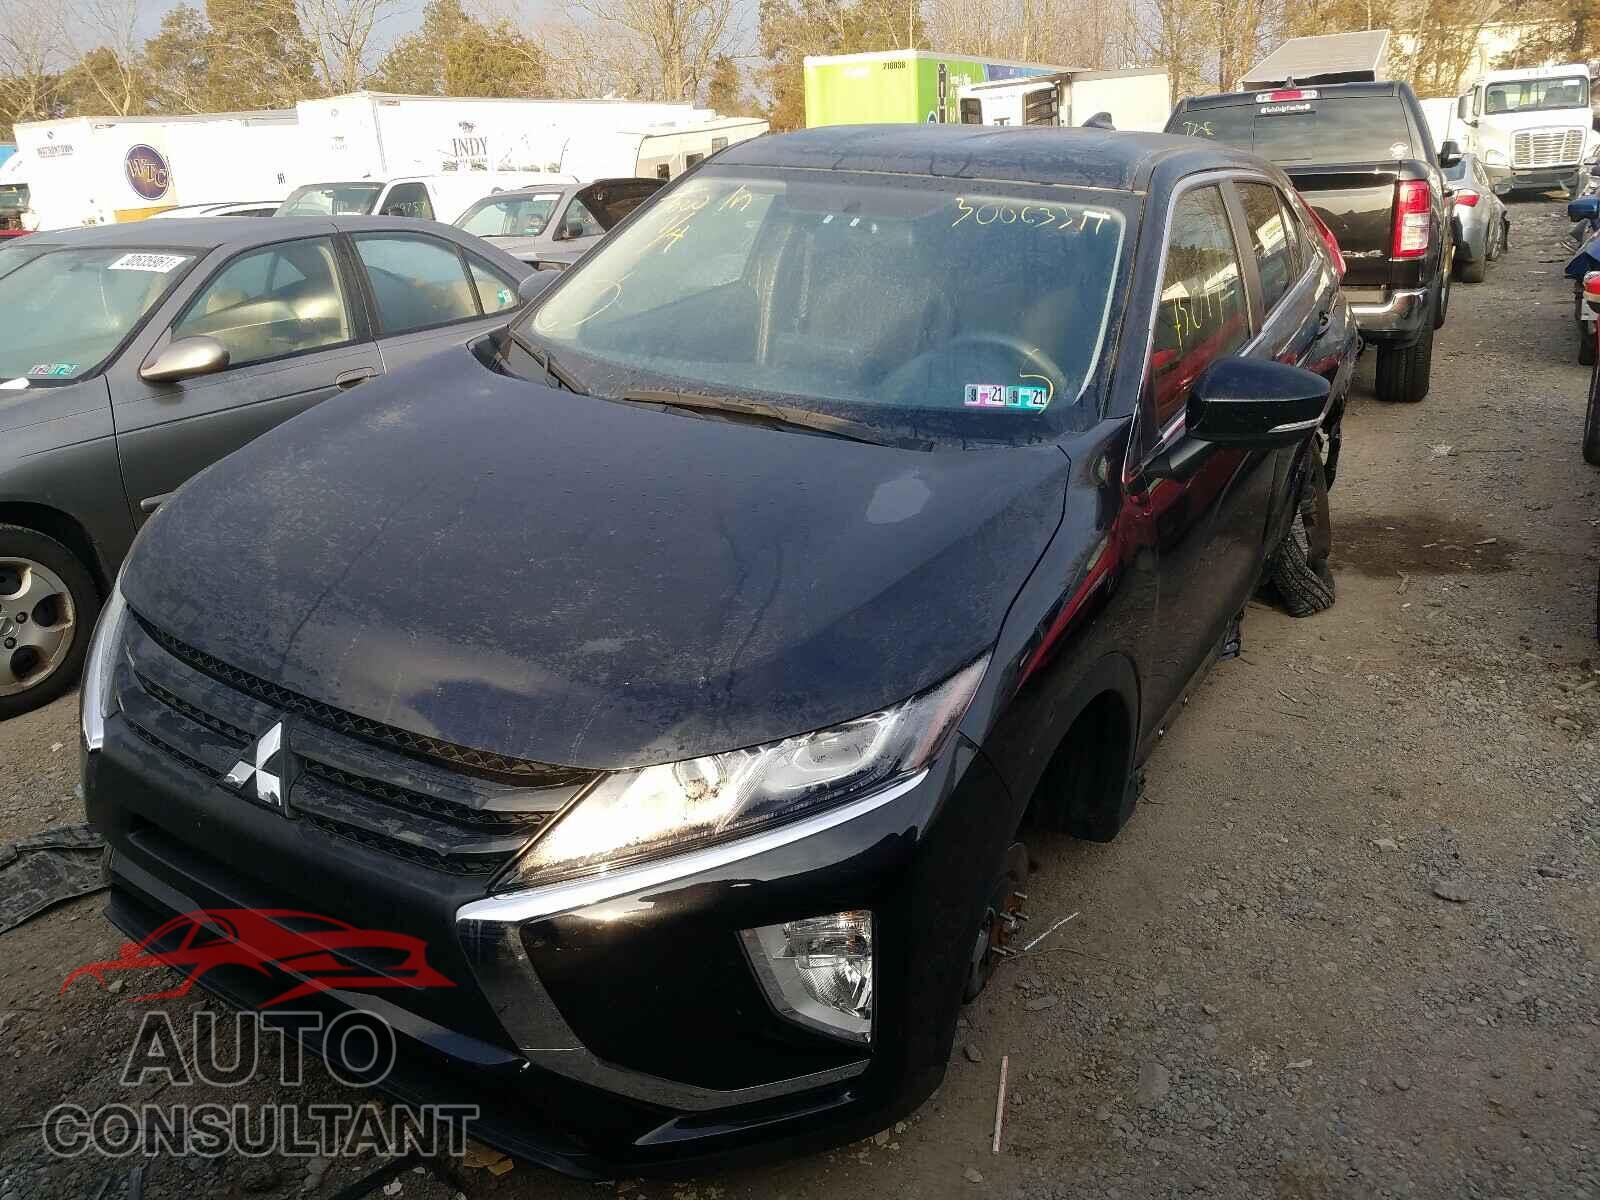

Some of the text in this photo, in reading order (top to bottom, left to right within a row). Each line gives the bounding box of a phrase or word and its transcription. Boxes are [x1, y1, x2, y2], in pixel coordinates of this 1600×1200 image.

[452, 136, 488, 157] INDY
[127, 158, 168, 189] WTC
[991, 386, 1003, 402] 21
[1032, 389, 1045, 405] 21
